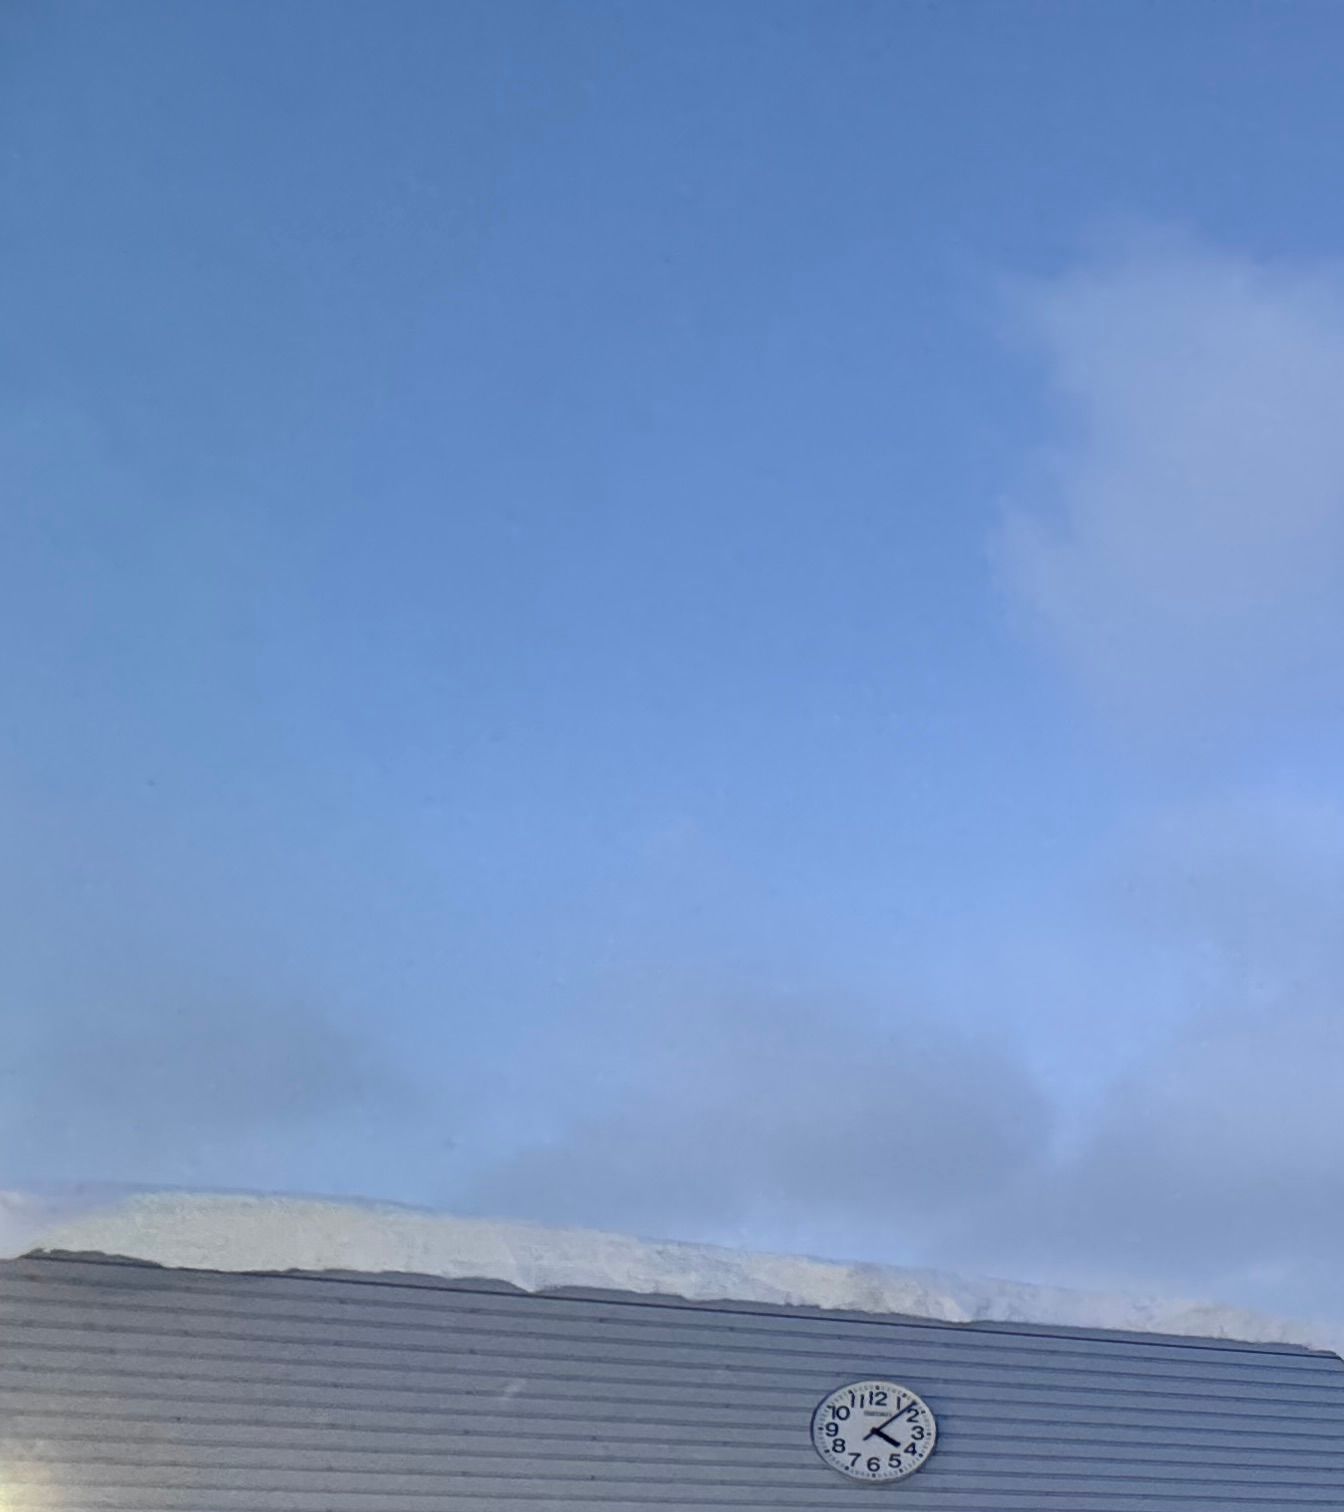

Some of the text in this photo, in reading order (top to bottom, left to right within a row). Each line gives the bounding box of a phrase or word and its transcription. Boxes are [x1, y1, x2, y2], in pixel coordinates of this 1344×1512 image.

[848, 1390, 865, 1409] 11
[868, 1390, 888, 1407] 12
[896, 1395, 901, 1410] 1
[826, 1405, 850, 1421] 10
[906, 1408, 920, 1423] 2
[825, 1422, 839, 1437] 9
[910, 1425, 925, 1441] 3
[831, 1438, 846, 1453] 8
[903, 1442, 918, 1456] 4
[848, 1452, 862, 1467] 7
[866, 1456, 881, 1472] 6
[887, 1453, 902, 1468] 5
